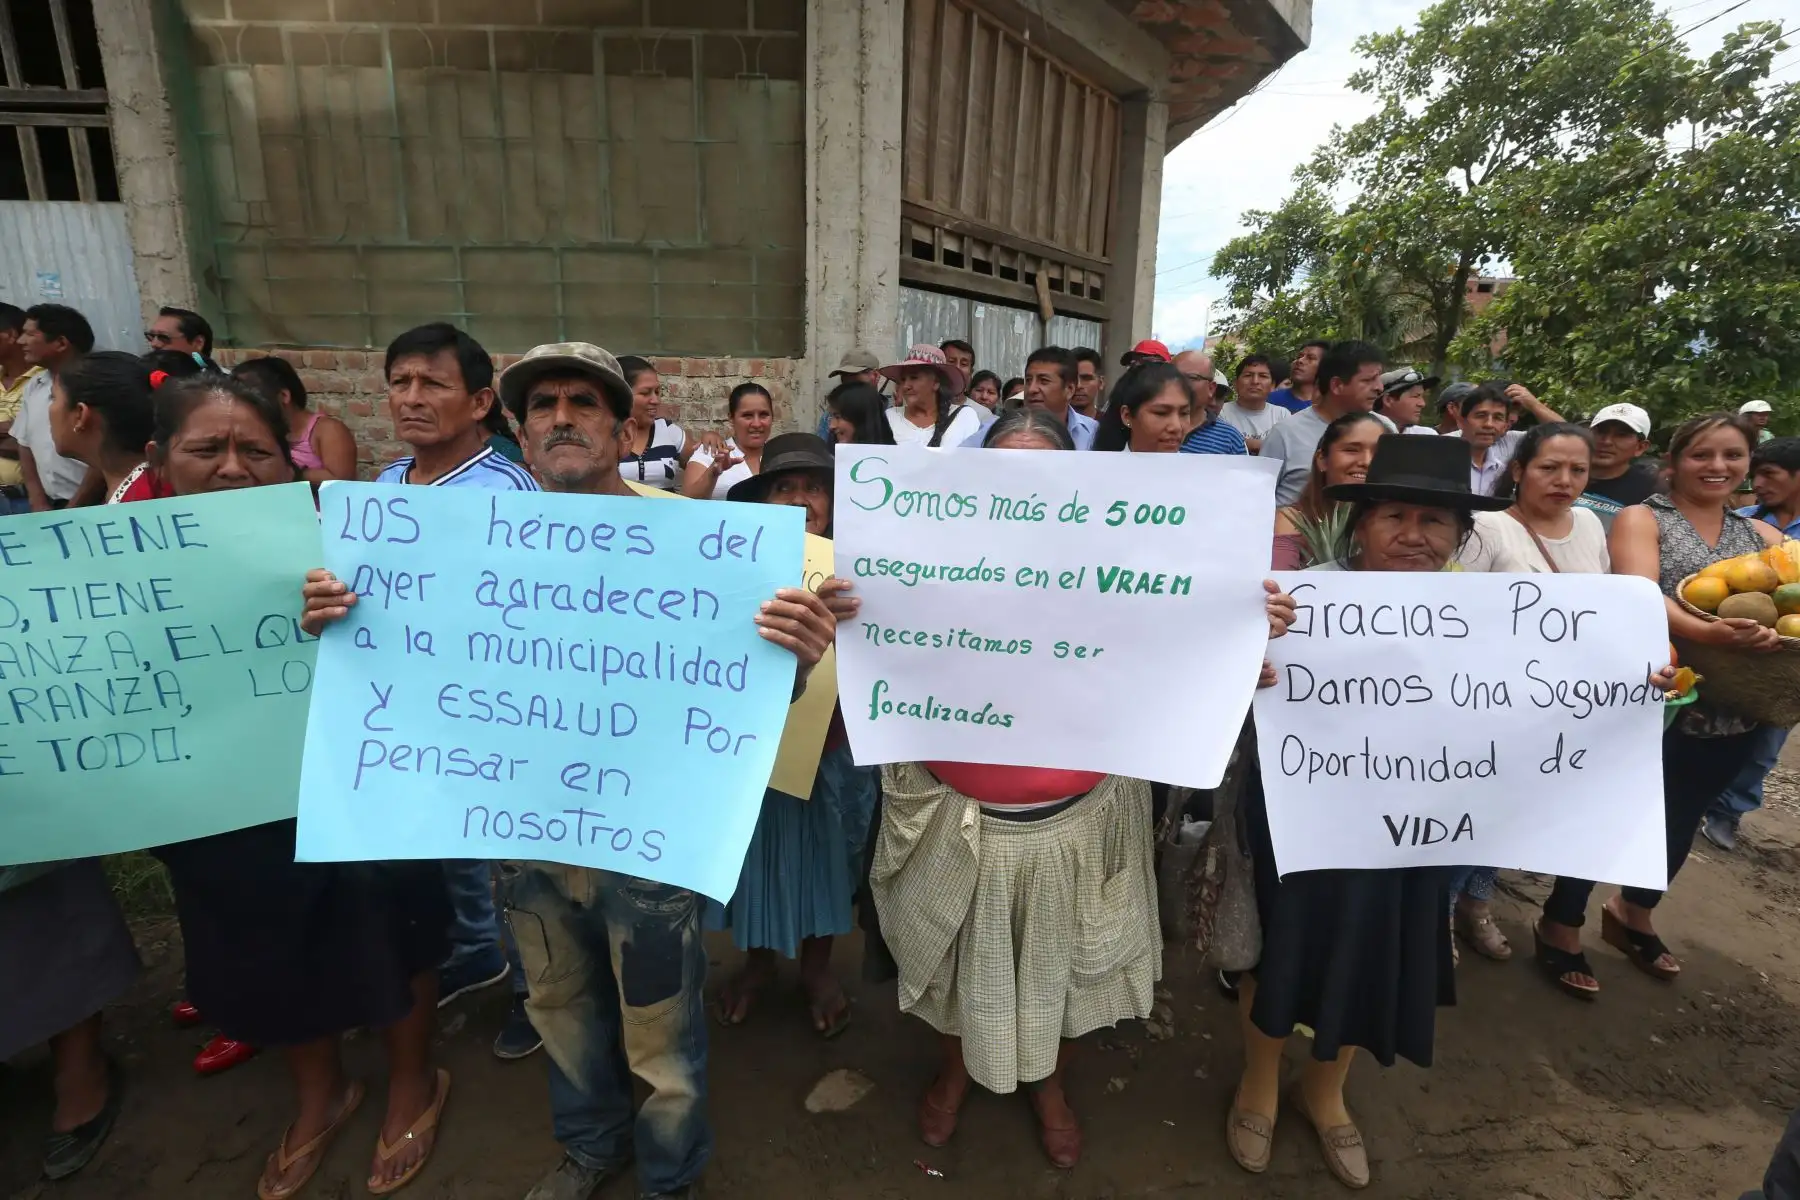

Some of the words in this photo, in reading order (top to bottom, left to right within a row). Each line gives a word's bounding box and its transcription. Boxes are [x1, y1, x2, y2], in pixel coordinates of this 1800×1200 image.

[850, 456, 978, 521] Somos
[988, 492, 1046, 522] más
[1058, 489, 1090, 523] de
[40, 512, 209, 560] TIENE
[340, 495, 421, 545] LOS
[698, 519, 764, 563] del
[474, 569, 720, 631] agradecen
[853, 556, 1006, 587] asegurados
[1015, 566, 1050, 590] en
[1058, 565, 1086, 590] el
[1096, 565, 1193, 596] VRAEM
[1286, 583, 1470, 639] Gracias
[1508, 580, 1598, 643] Por
[165, 624, 244, 662] EL
[354, 626, 378, 650] a
[405, 624, 436, 657] la
[467, 631, 749, 692] municipalidad
[861, 622, 1033, 655] necesitamos
[1053, 640, 1105, 659] ser
[248, 660, 312, 698] LO
[1285, 663, 1434, 707] Darnos
[438, 682, 638, 738] ESSALUD
[868, 679, 1016, 729] focalizados
[560, 761, 631, 797] en
[1280, 731, 1497, 784] Oportunidad
[1539, 731, 1588, 775] de
[1382, 812, 1474, 847] VIDA
